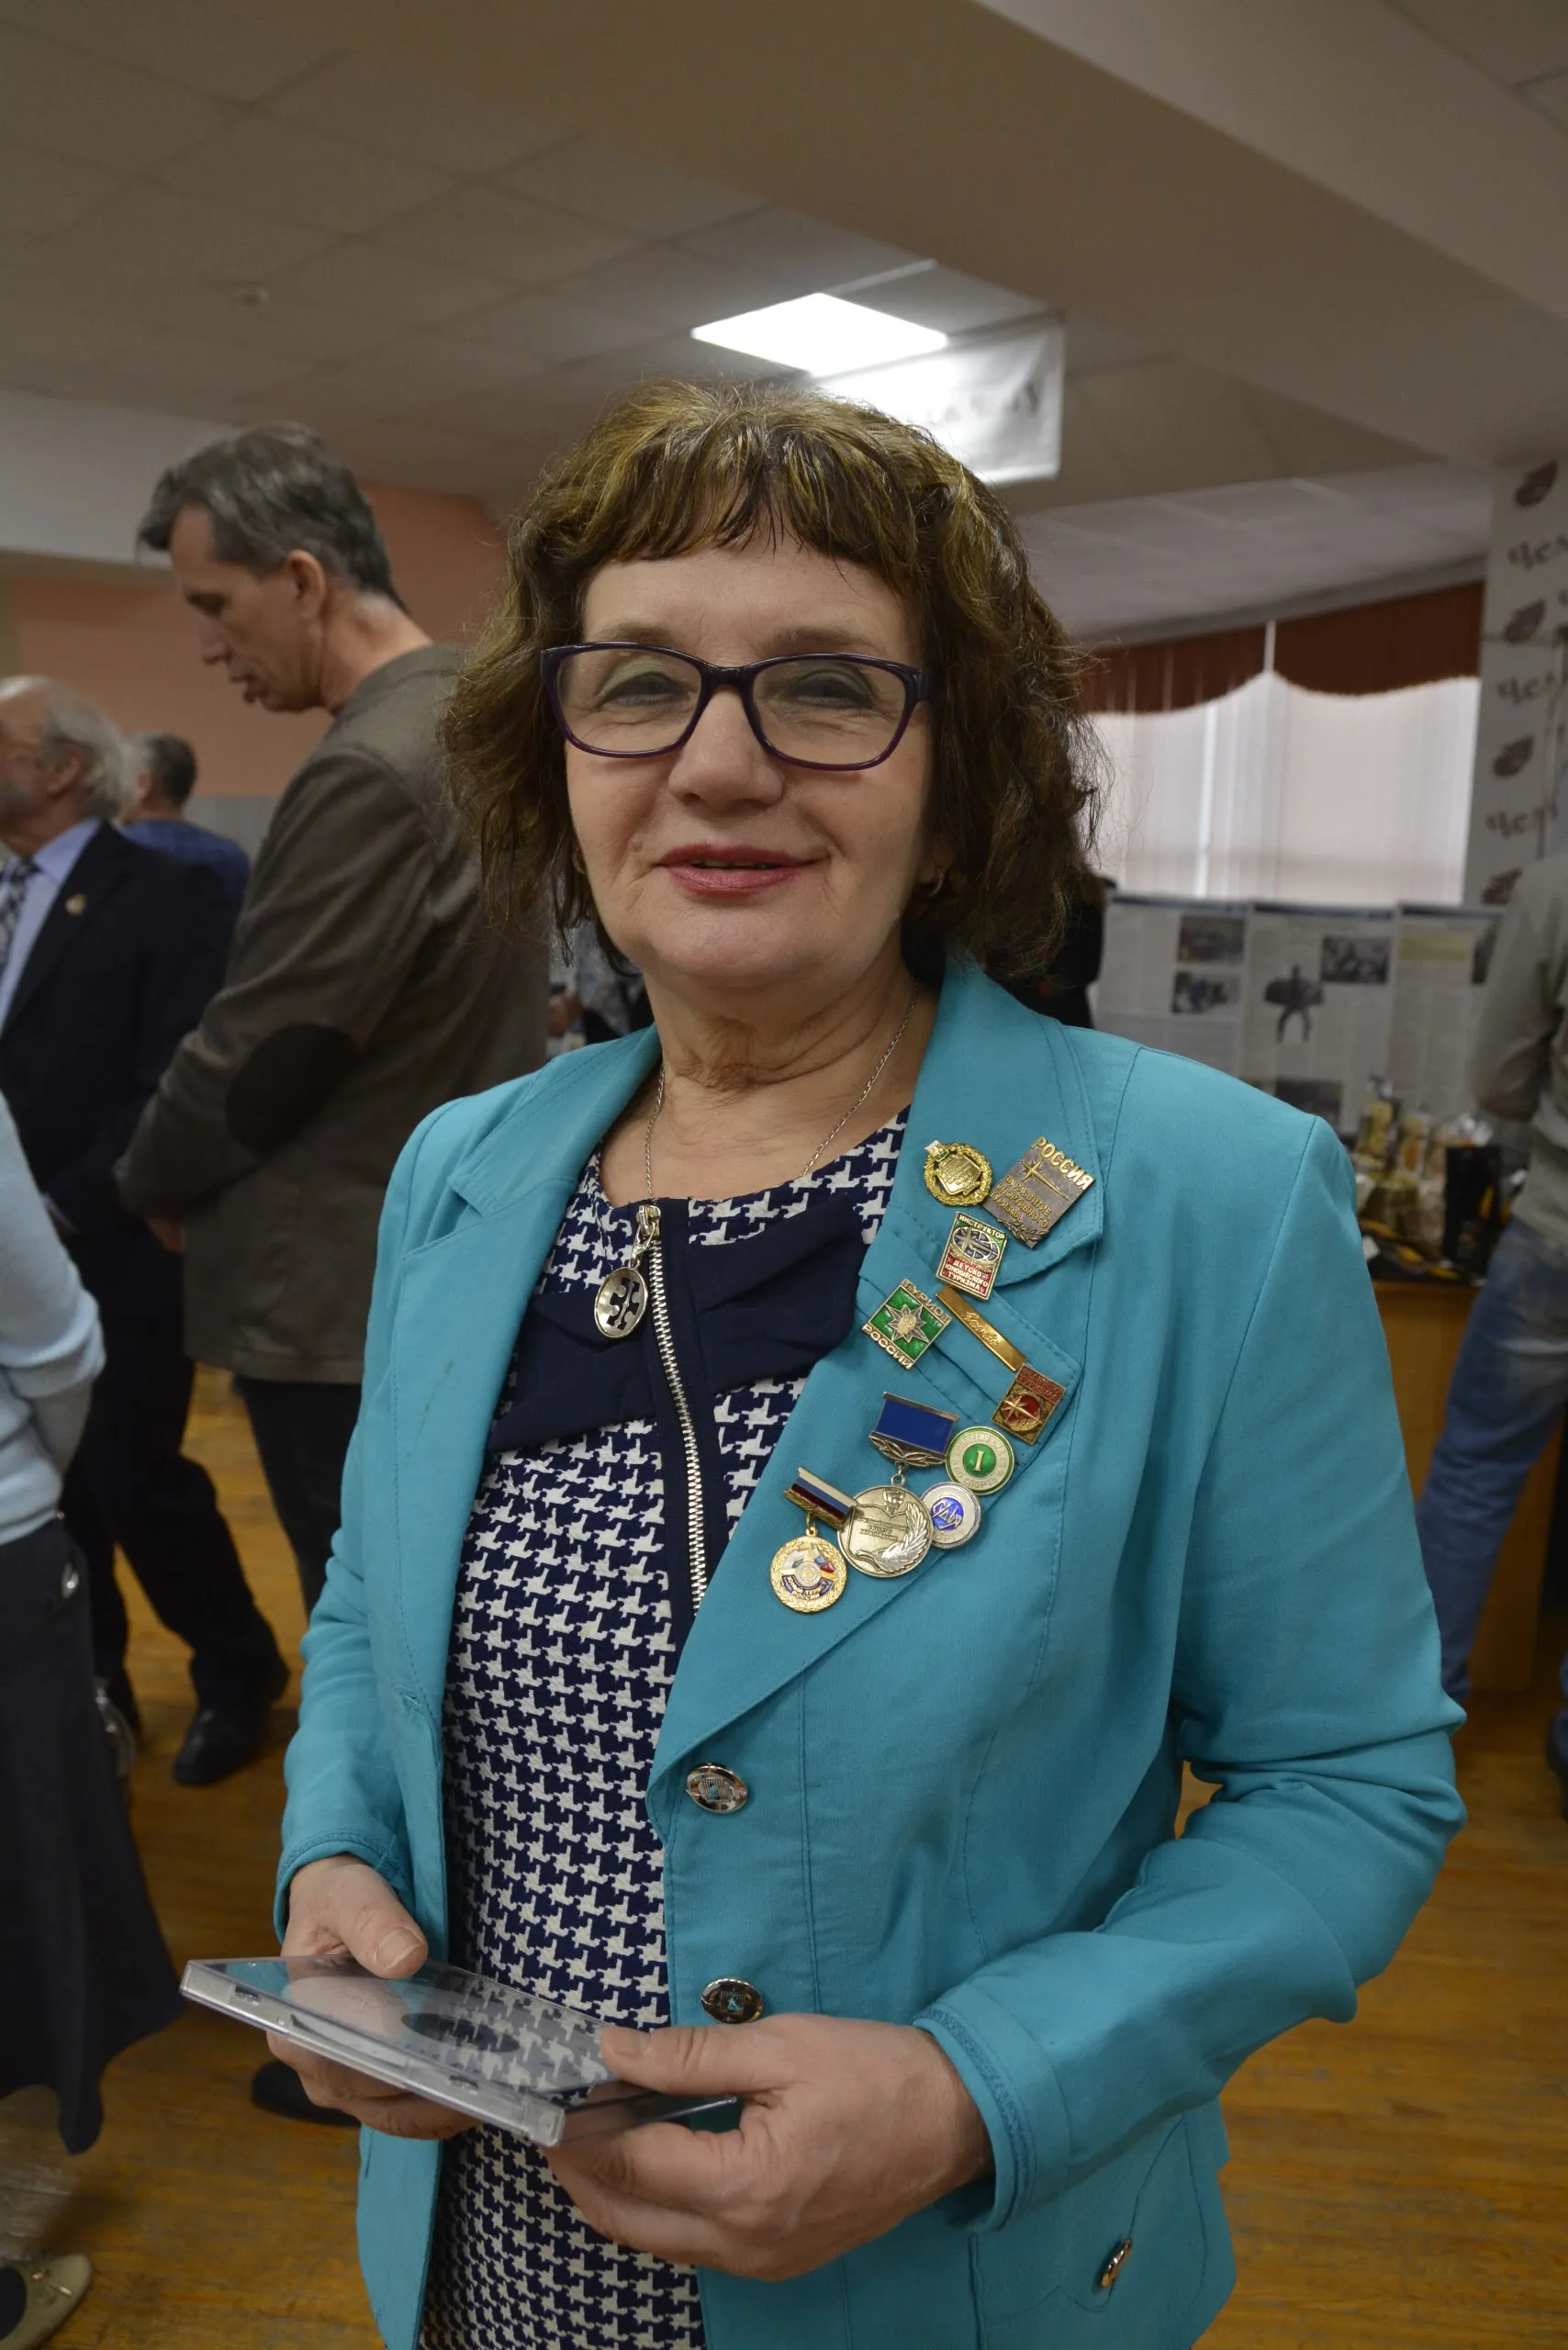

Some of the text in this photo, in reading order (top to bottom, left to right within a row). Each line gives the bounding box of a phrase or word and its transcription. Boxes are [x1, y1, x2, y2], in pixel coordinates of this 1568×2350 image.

[1030, 1135, 1095, 1191] РОССИЯ
[991, 1191, 1022, 1222] ТУРИЗМА
[997, 1182, 1048, 1228] СПОРТИВНОГО
[1004, 1175, 1052, 1217] ЗА РАЗВИТИЕ
[958, 1214, 1005, 1239] ИНСТРУКТОР
[945, 1263, 989, 1288] ЮНОШЕСКОГО
[947, 1270, 981, 1291] ТУРИЗМА
[901, 1278, 952, 1324] ТУРИСТ
[862, 1323, 914, 1369] РОССИИ
[791, 1590, 821, 1600] РОССИИ
